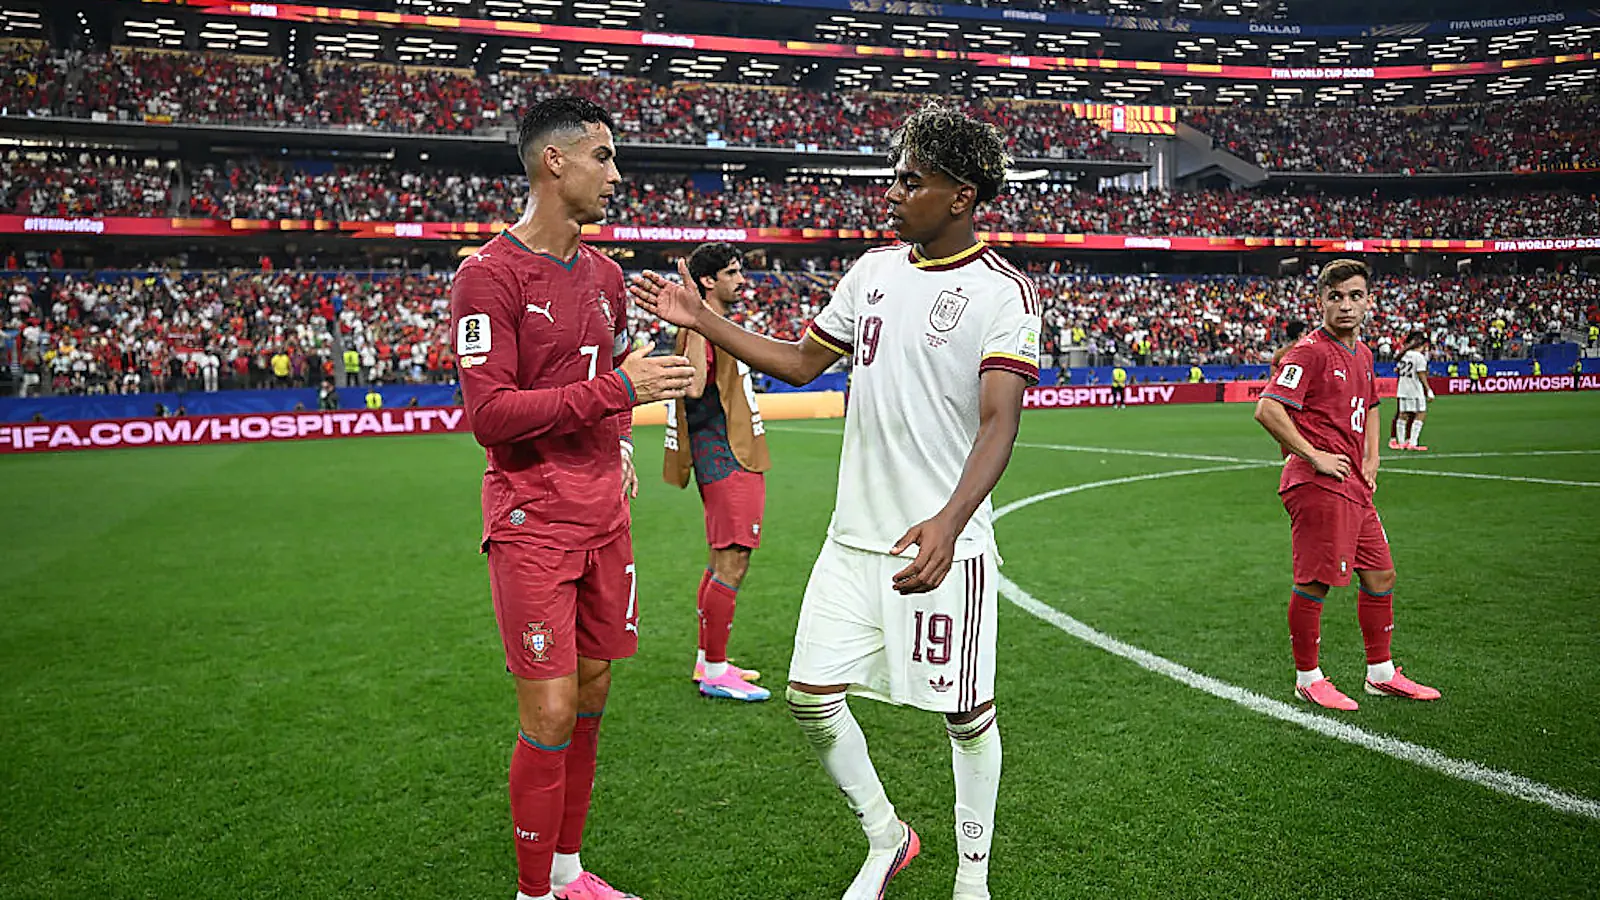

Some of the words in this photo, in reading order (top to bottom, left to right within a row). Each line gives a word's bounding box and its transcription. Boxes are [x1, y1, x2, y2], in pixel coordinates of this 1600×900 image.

[1249, 24, 1301, 34] DALLAS
[1449, 21, 1470, 29] FIFA
[1471, 19, 1506, 28] WORLD
[1507, 17, 1527, 26] CUP
[1271, 68, 1291, 77] FIFA
[1291, 68, 1323, 77] WORLD
[1324, 68, 1342, 77] CUP
[614, 227, 639, 239] FIFA
[640, 228, 682, 239] WORLD
[683, 228, 706, 240] CUP
[1494, 241, 1517, 251] FIFA
[1517, 240, 1554, 250] WORLD
[1554, 239, 1576, 249] CUP
[855, 315, 883, 366] 19
[579, 345, 600, 381] 7
[625, 563, 636, 619] 7
[912, 610, 953, 664] 19
